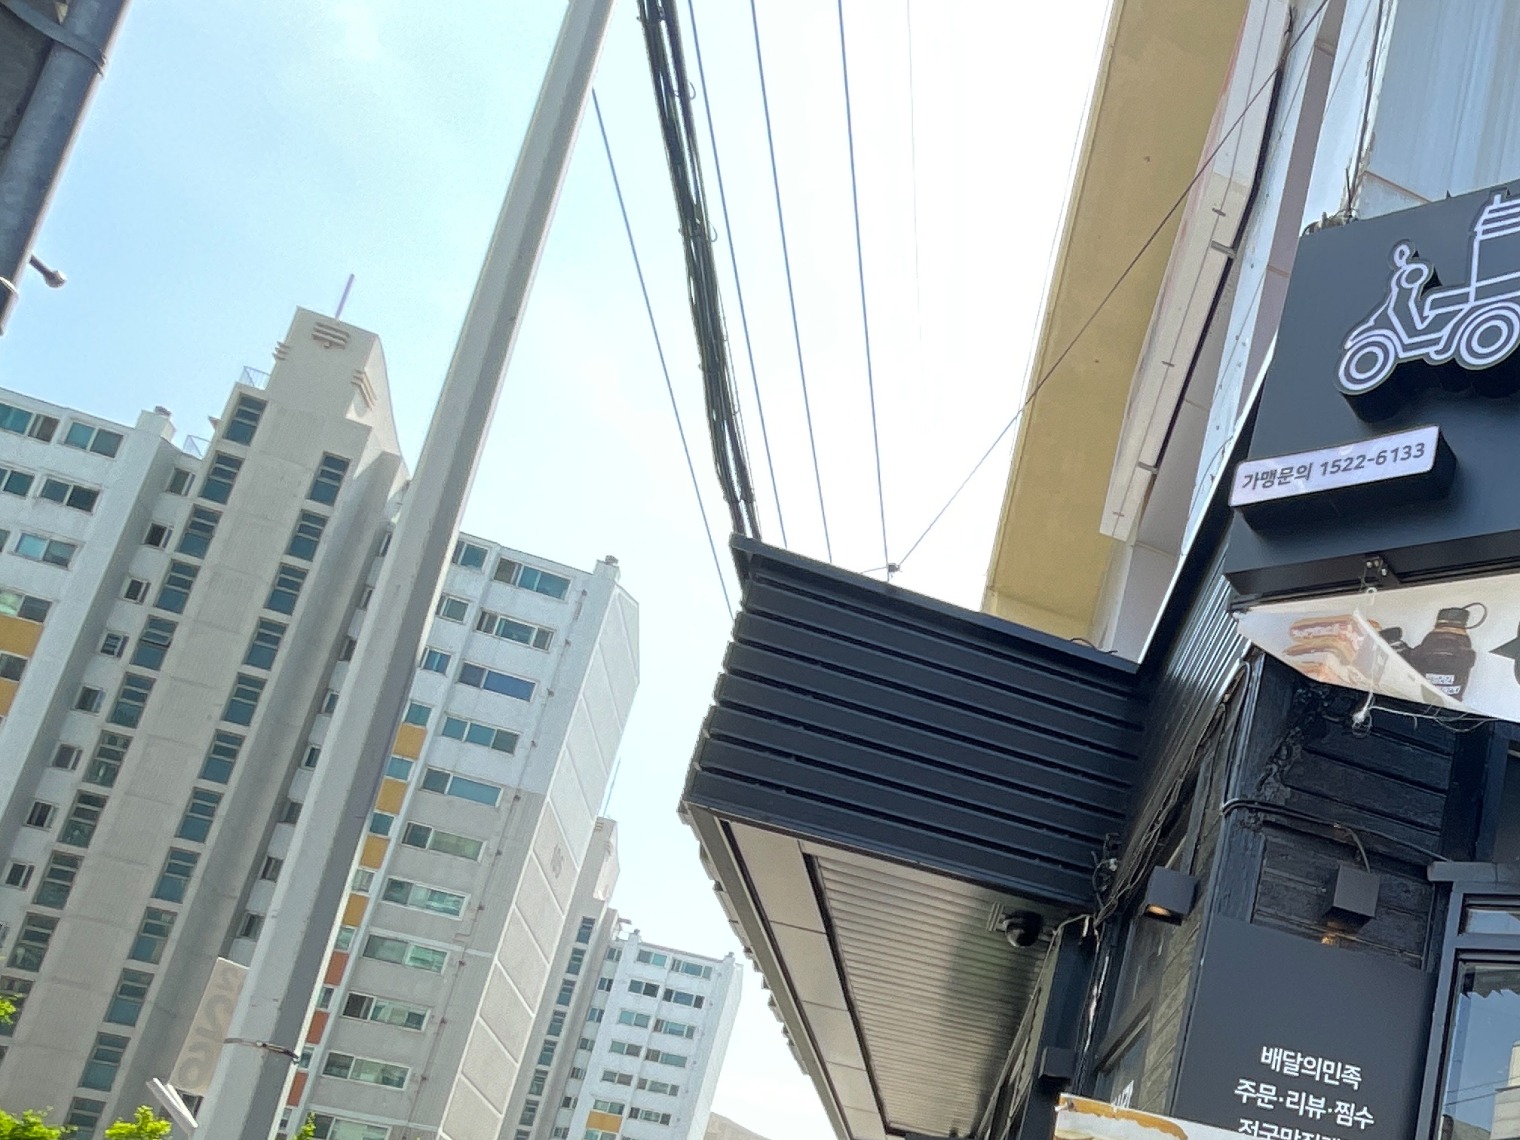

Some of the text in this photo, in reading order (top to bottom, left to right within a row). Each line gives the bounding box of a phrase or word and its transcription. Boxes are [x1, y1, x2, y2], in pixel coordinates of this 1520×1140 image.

[1242, 442, 1425, 491] 가맹문의 1522-6133
[1260, 1046, 1362, 1091] 배달의민족
